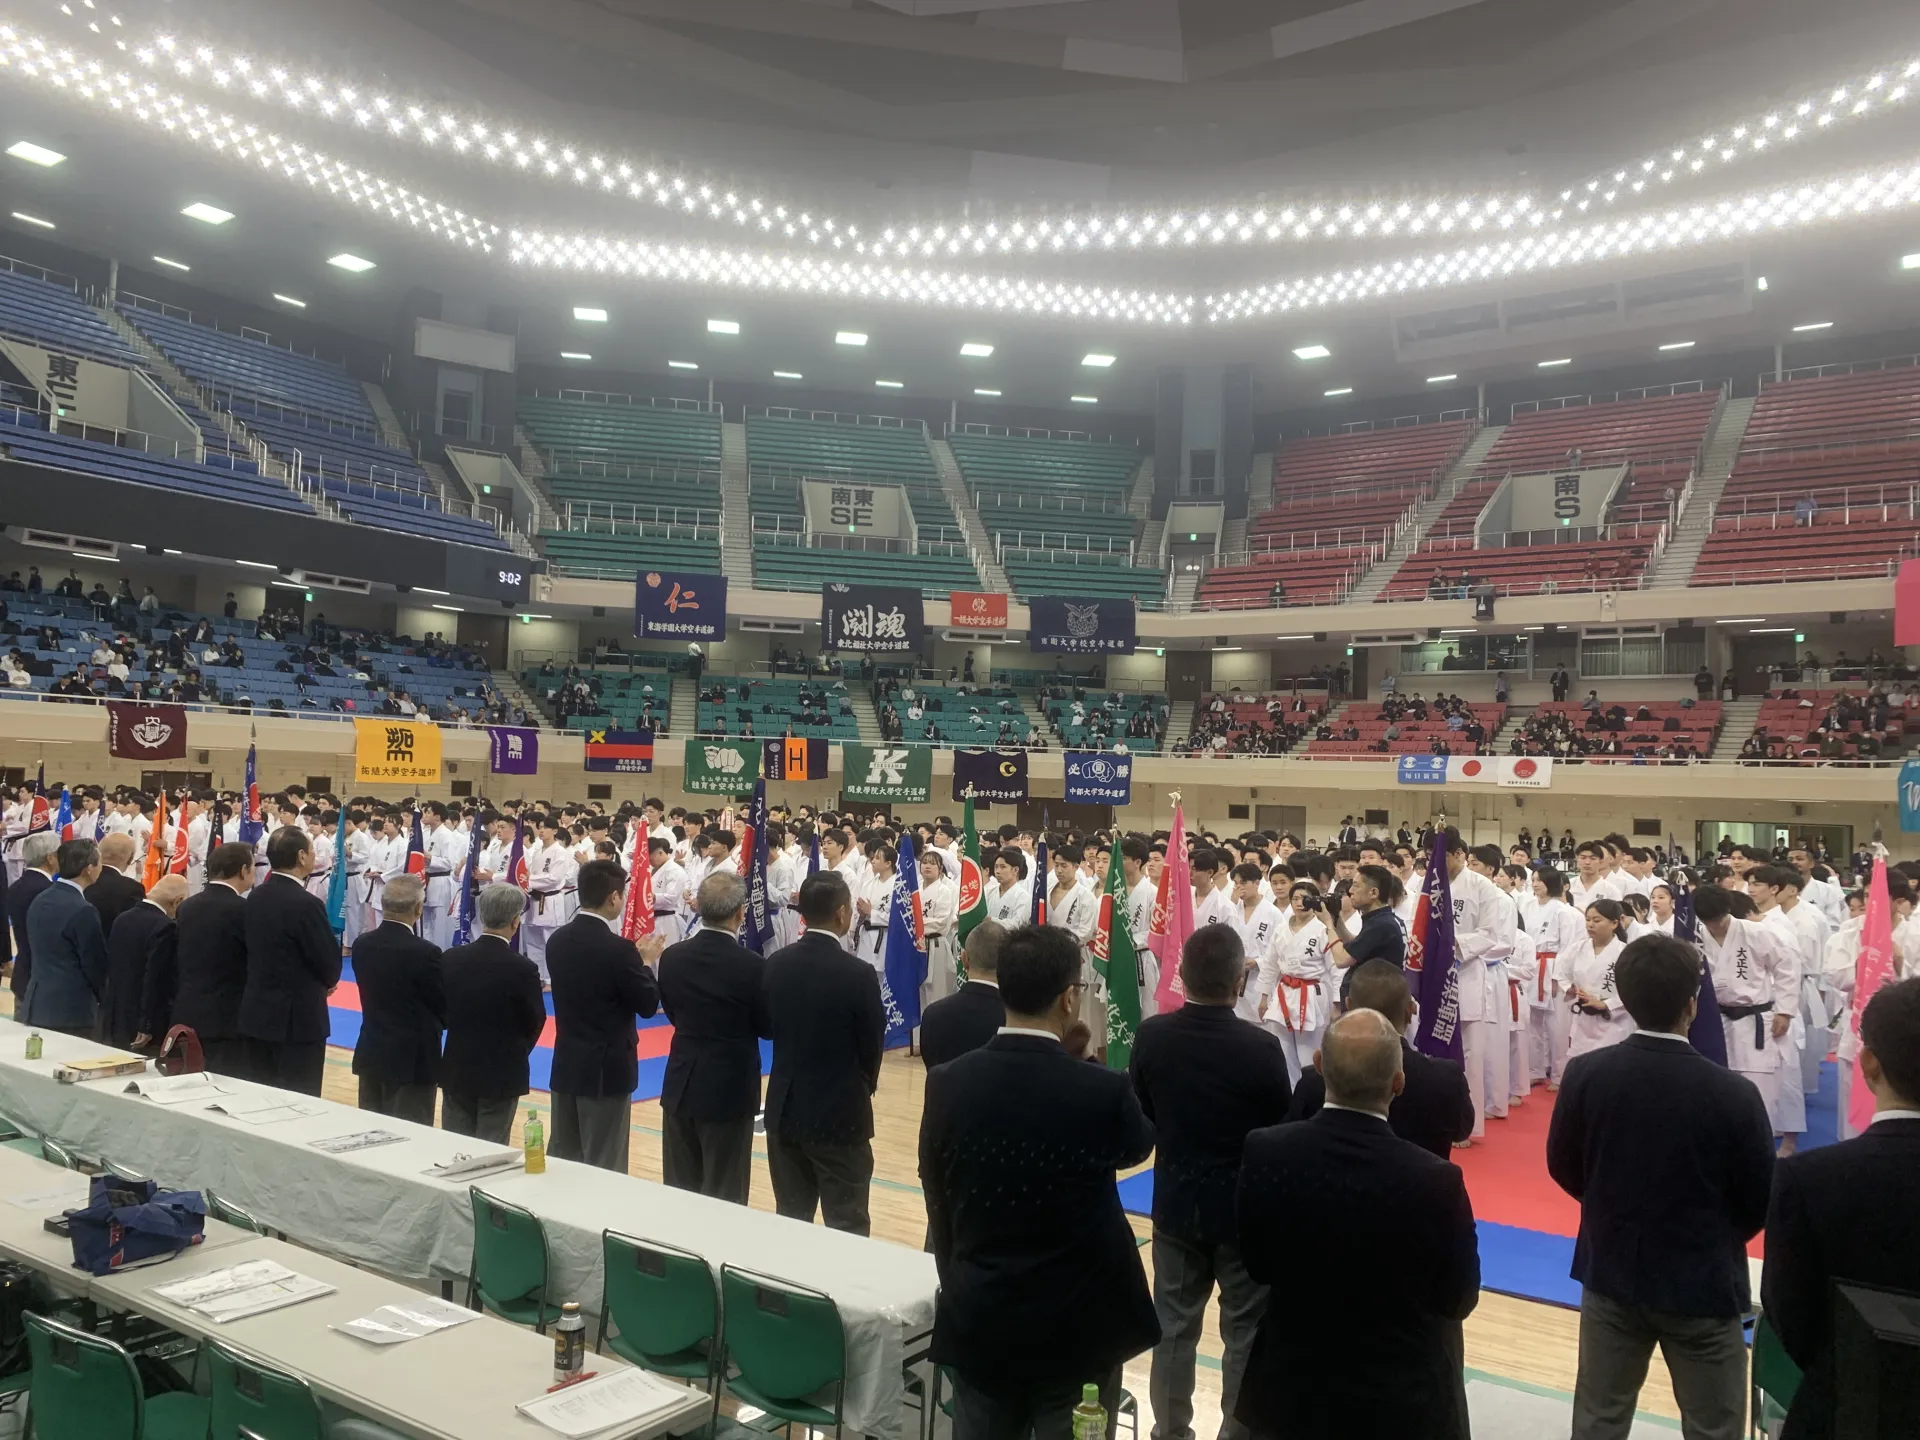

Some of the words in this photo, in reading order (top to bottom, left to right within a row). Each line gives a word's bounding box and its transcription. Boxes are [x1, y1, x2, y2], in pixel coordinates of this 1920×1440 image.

[46, 353, 79, 384] 東
[1554, 474, 1581, 497] 南
[831, 486, 875, 507] 南東
[830, 506, 873, 527] SE
[1554, 496, 1581, 519] S
[499, 570, 522, 586] 9:02
[664, 582, 700, 614] 仁
[647, 621, 715, 635] 東海学園大学空手道部
[837, 638, 910, 650] 東北福祉大学空手道部
[789, 747, 803, 772] H
[865, 748, 910, 785] K
[1068, 762, 1081, 776] 必
[1116, 764, 1129, 778] 勝
[959, 789, 1023, 799] 東都市大学空手道部
[1069, 787, 1126, 798] 中部大学空手道部
[1452, 899, 1465, 925] 明大
[1255, 922, 1268, 941] 日大
[1304, 938, 1317, 957] 日大
[1736, 947, 1748, 980] 大正大
[1602, 961, 1615, 993] 大正大
